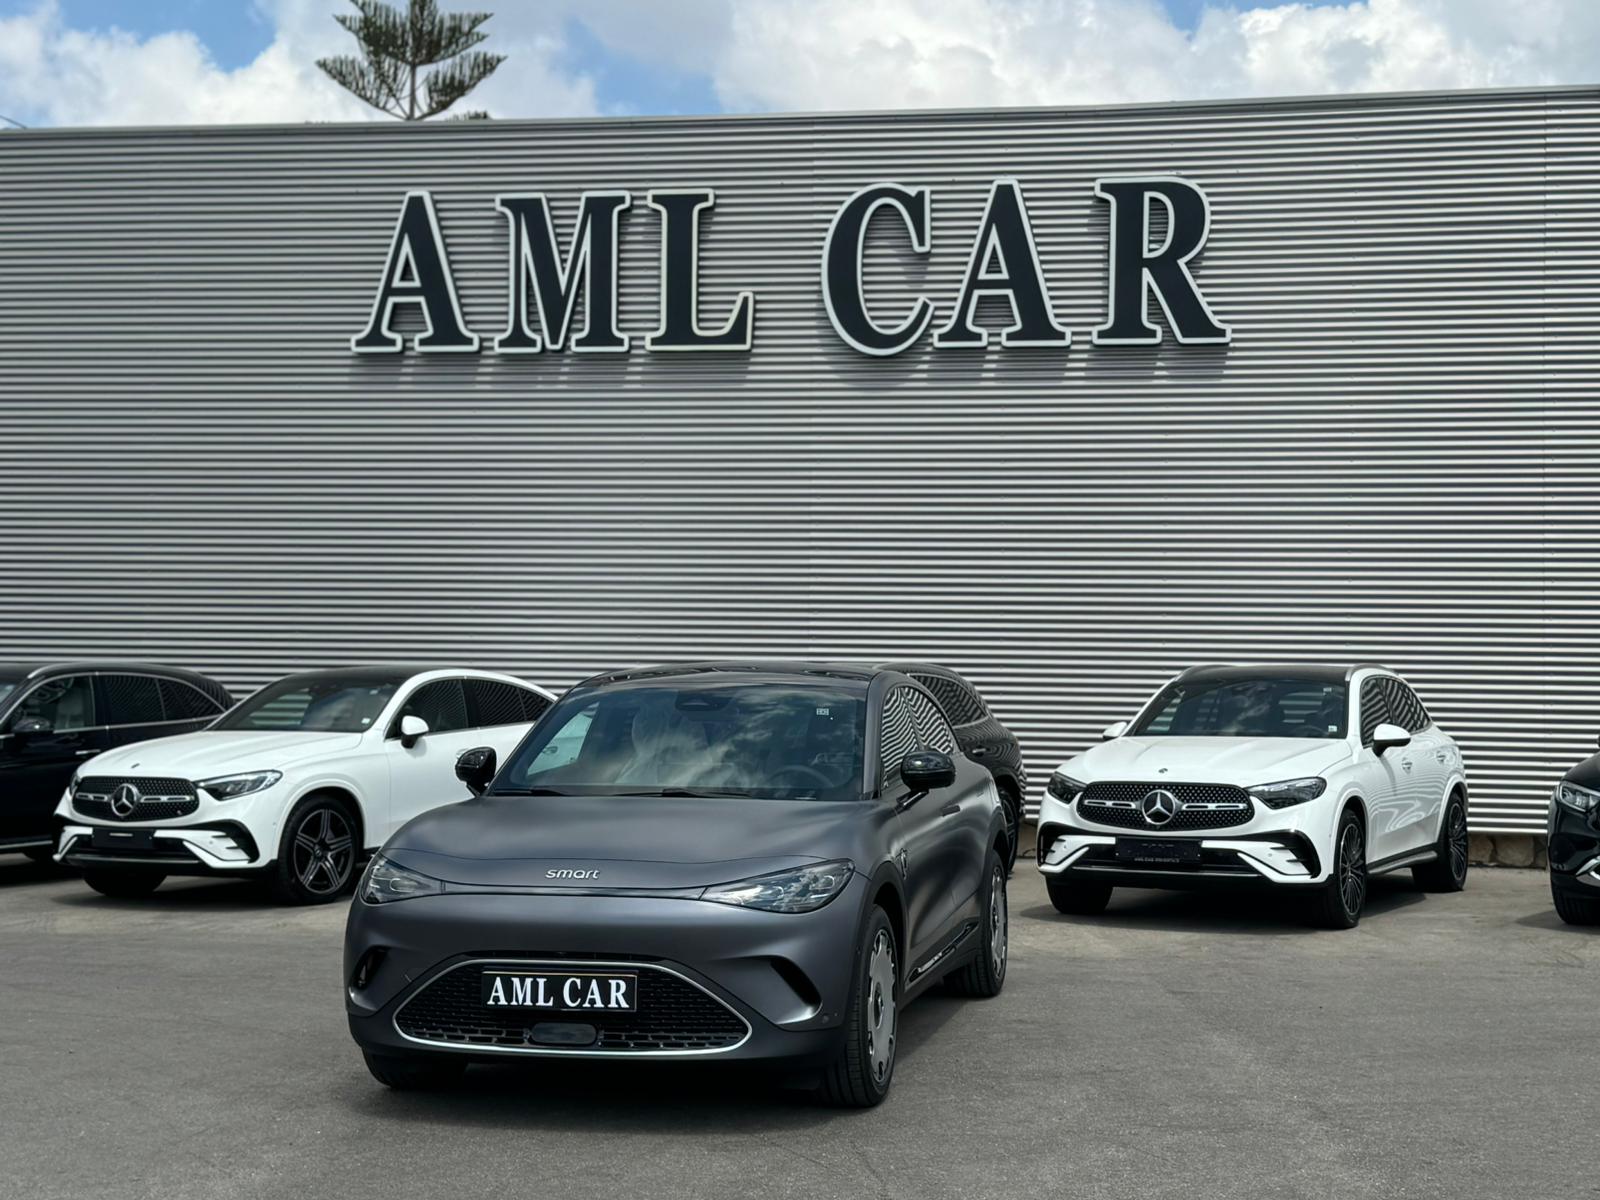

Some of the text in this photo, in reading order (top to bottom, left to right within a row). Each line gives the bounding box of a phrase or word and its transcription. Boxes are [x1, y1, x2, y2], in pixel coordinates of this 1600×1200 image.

[350, 175, 1233, 357] AML CAR
[545, 869, 600, 879] smart
[486, 976, 630, 1009] AML CAR
